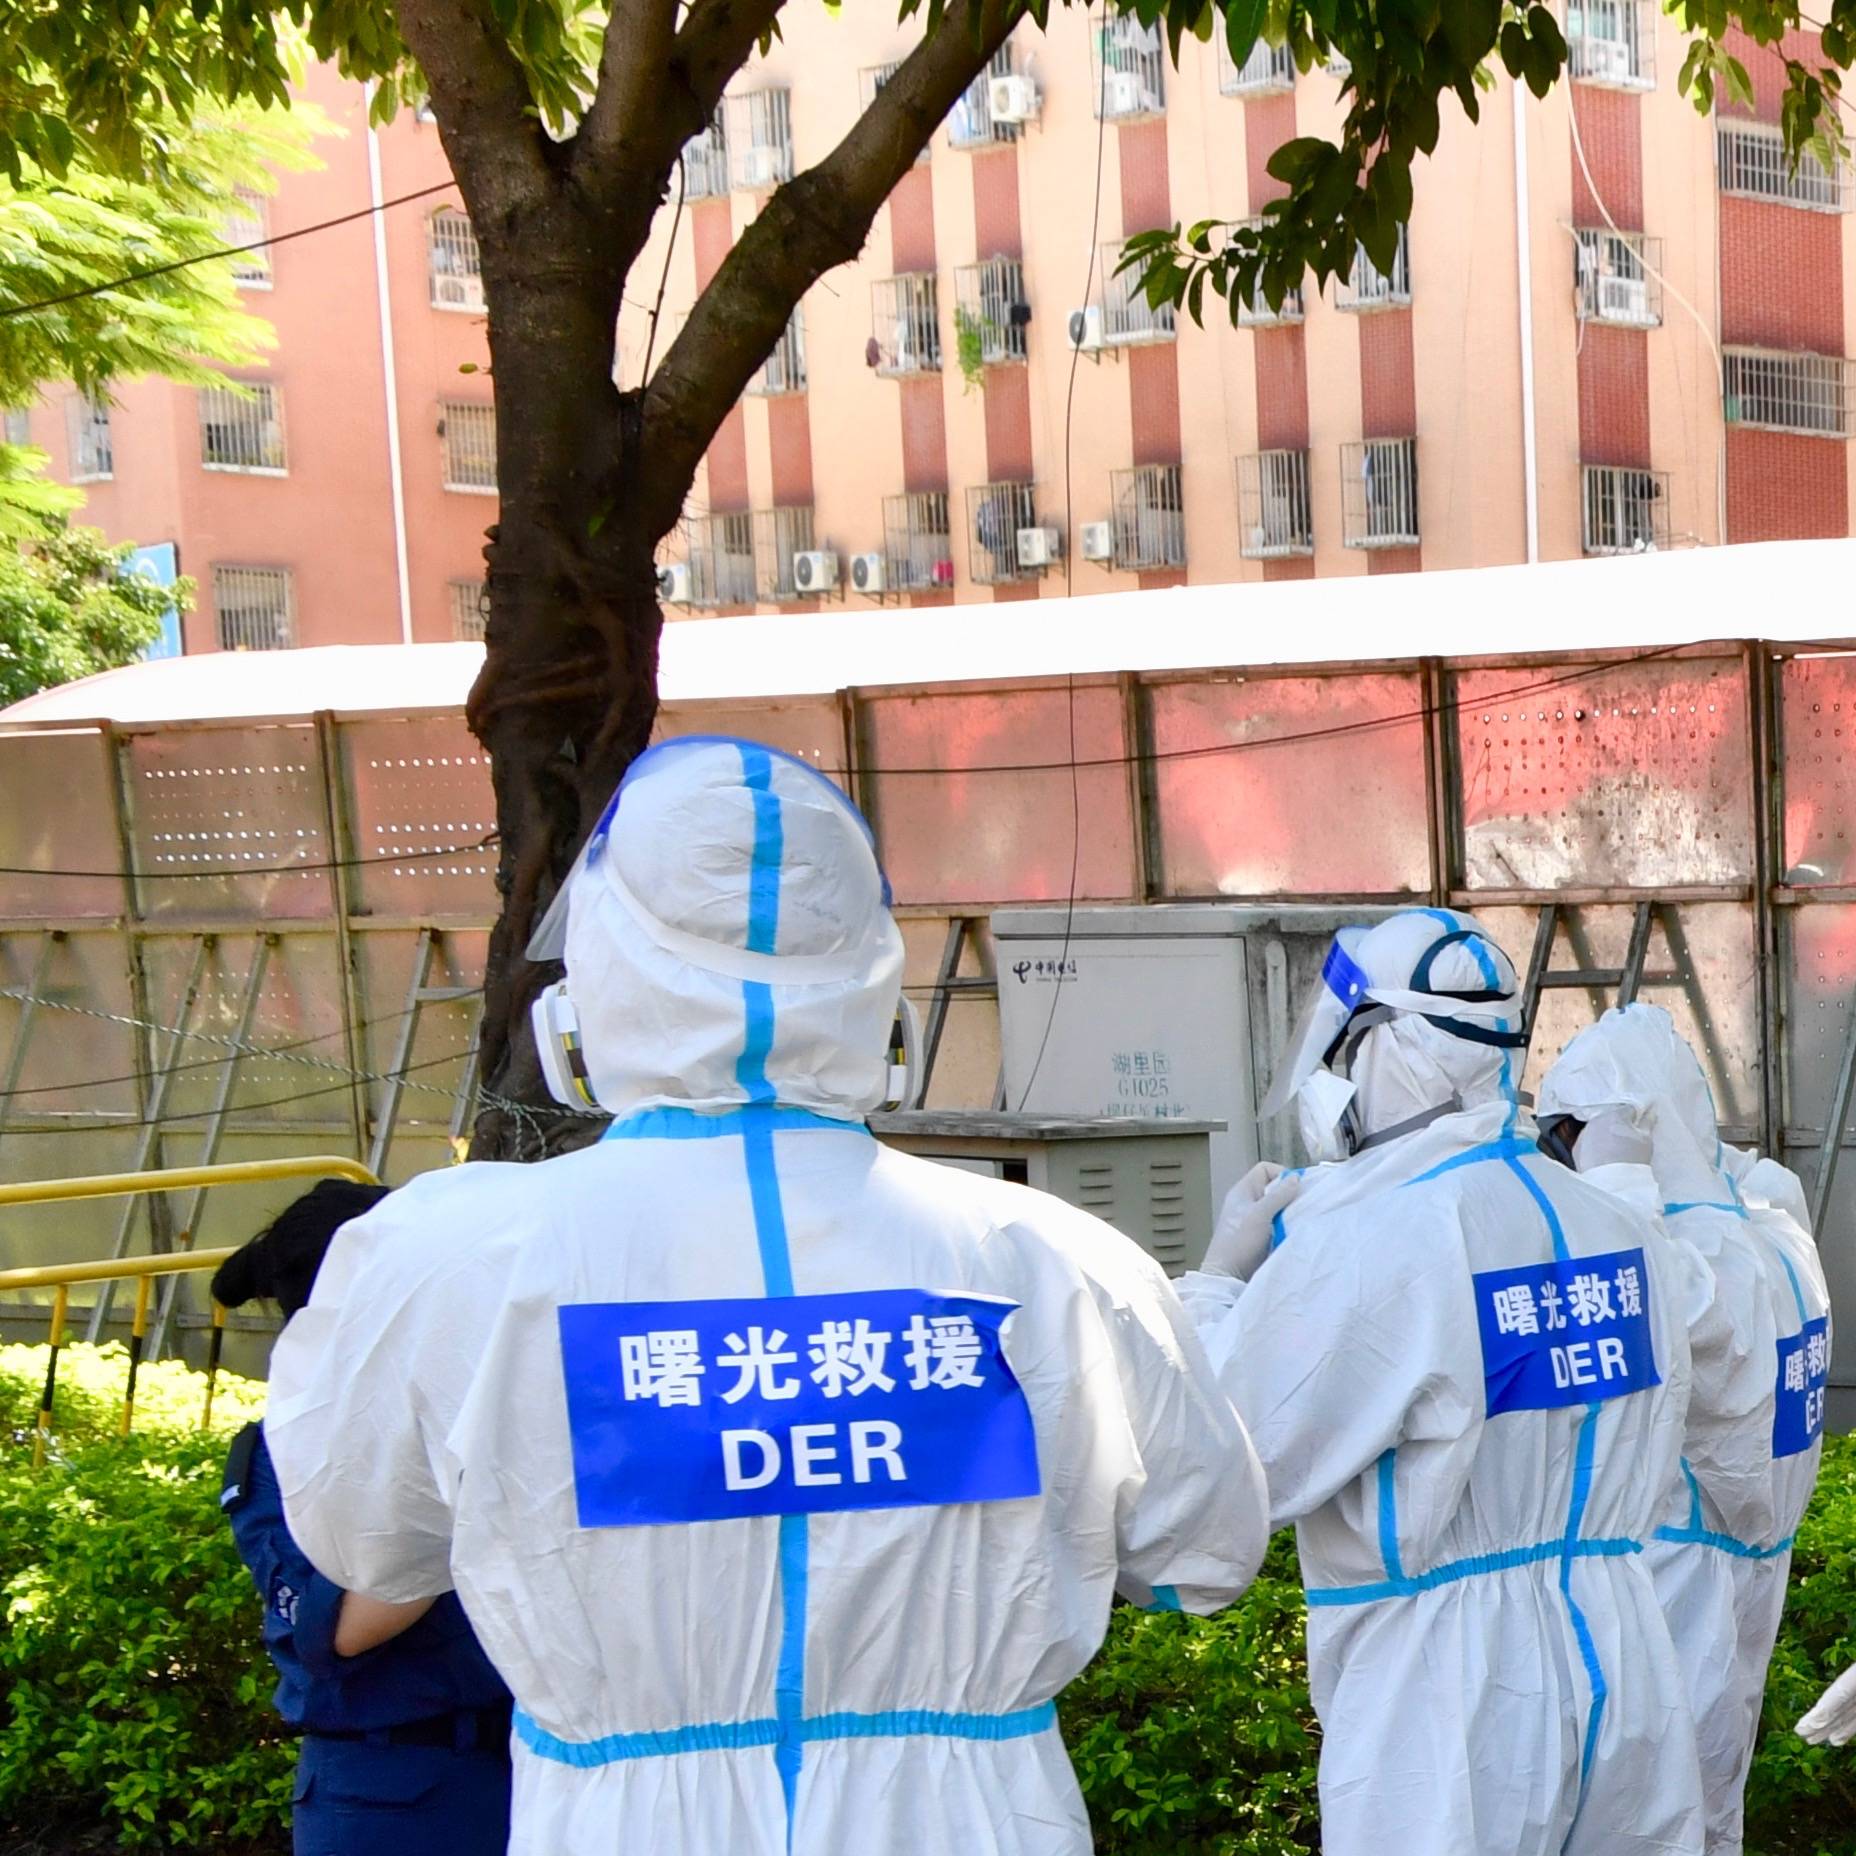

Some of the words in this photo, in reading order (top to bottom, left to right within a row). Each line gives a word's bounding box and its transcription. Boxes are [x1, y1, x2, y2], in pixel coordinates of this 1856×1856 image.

[1493, 1266, 1643, 1337] 曙光救援
[618, 1314, 986, 1408] 曙光救援
[1550, 1337, 1629, 1389] DER
[719, 1419, 908, 1492] DER
